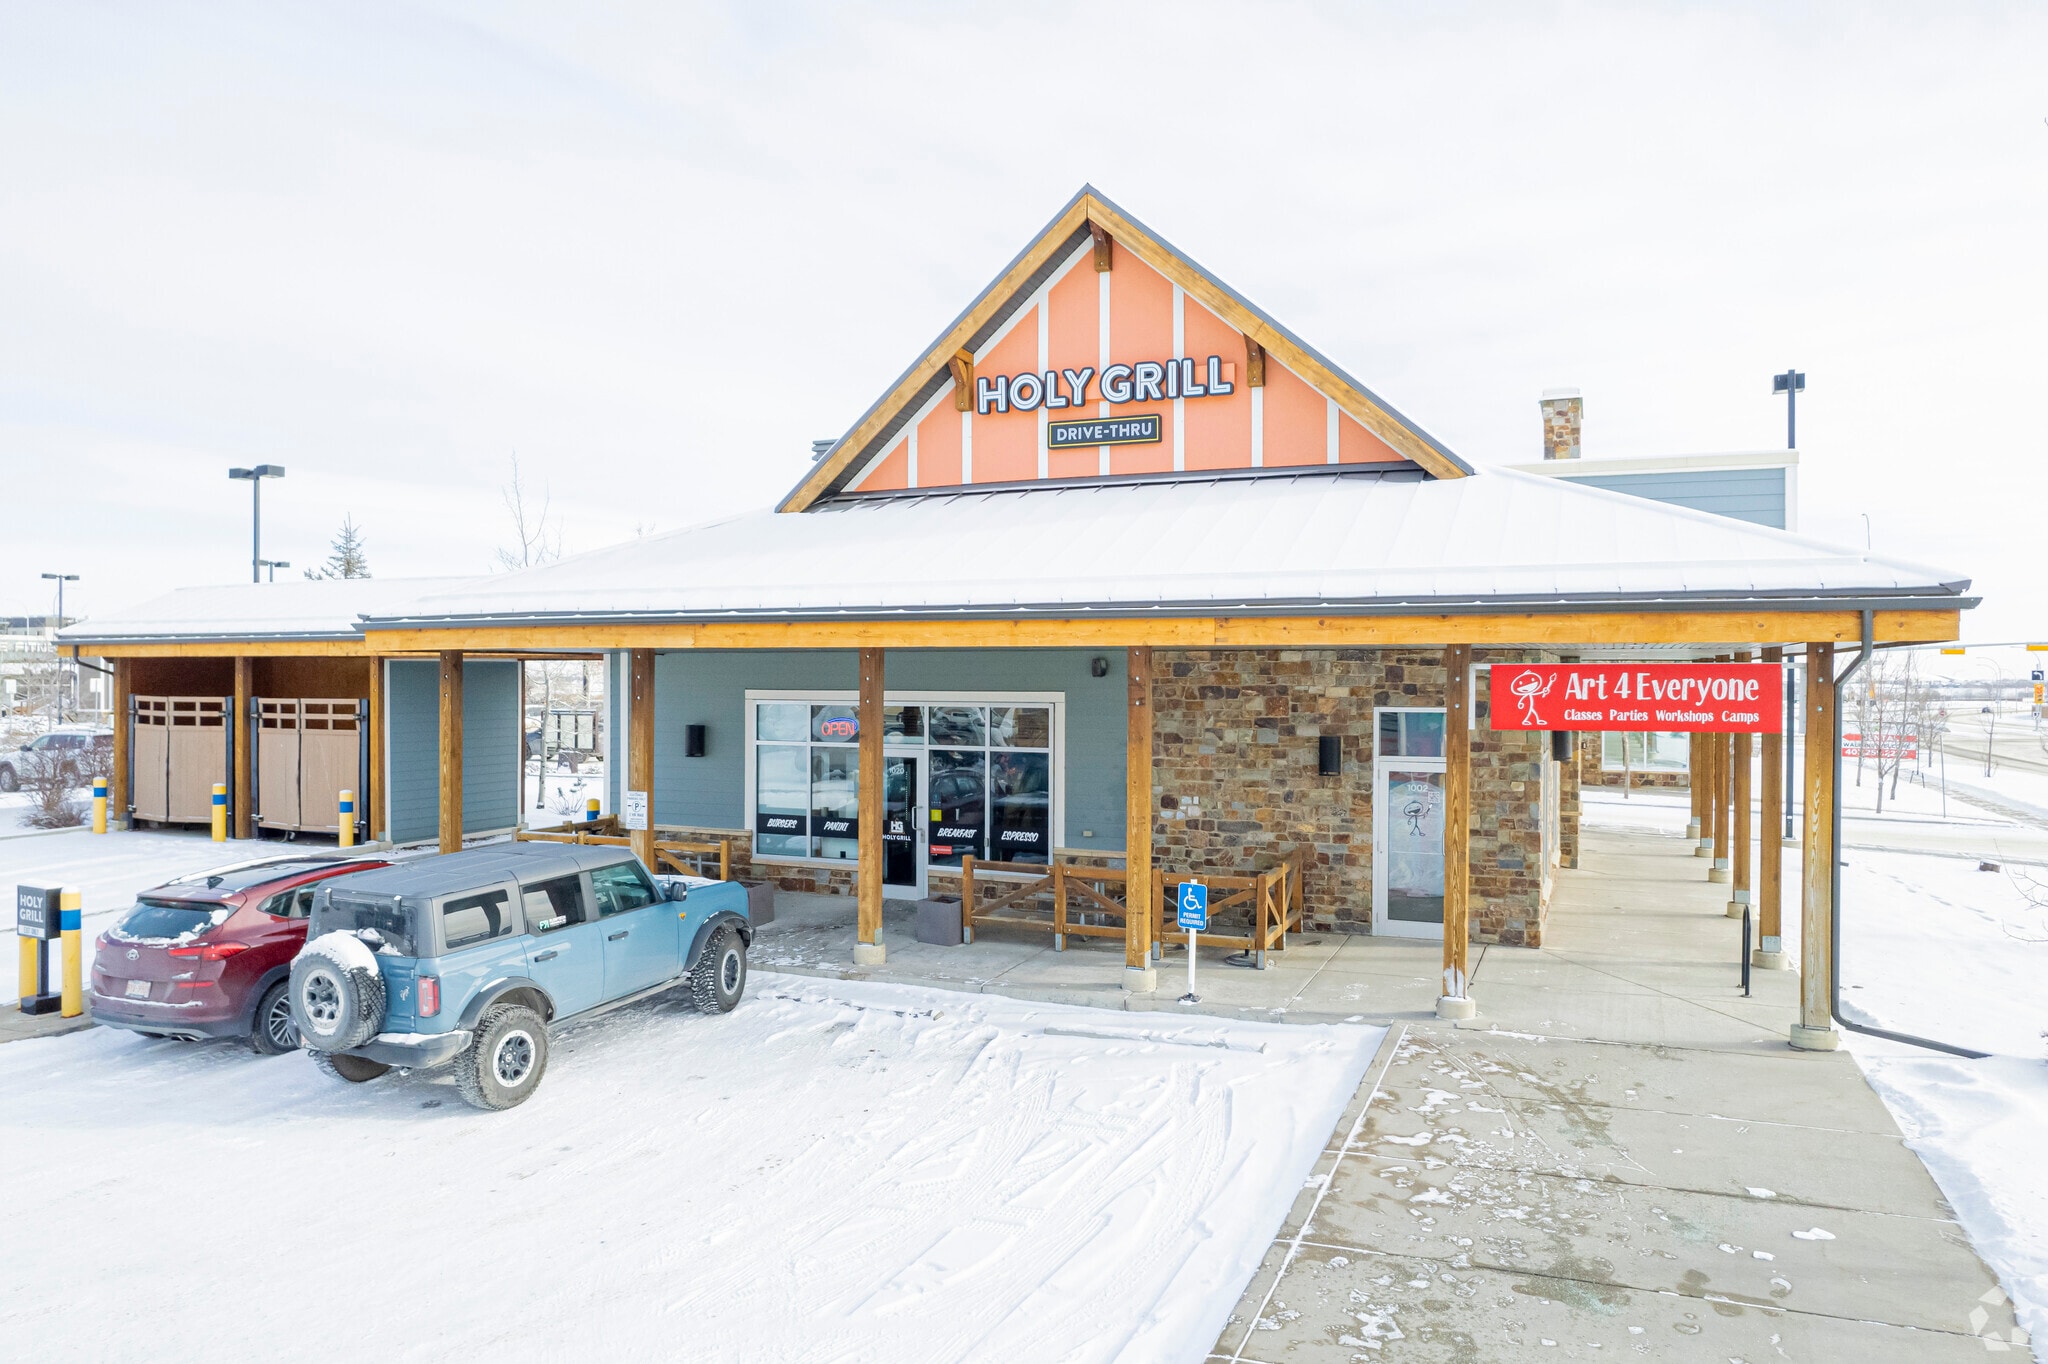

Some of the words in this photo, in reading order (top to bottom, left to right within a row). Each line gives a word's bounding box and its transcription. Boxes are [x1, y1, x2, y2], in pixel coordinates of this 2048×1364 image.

[977, 367, 1094, 414] HOLY
[1100, 355, 1234, 403] GRILL
[1056, 422, 1152, 441] DRIVE-THRU
[15, 642, 58, 652] FITNE
[1565, 672, 1608, 701] Art
[1614, 672, 1631, 700] 4
[1637, 672, 1759, 706] Everyone
[1564, 709, 1602, 721] Classes
[1609, 709, 1648, 721] Parties
[1656, 709, 1714, 724] Workshops
[1722, 710, 1759, 724] Camps
[821, 721, 856, 736] OPEN
[889, 767, 905, 775] 1020
[1407, 784, 1429, 792] 1002
[634, 802, 640, 811] P
[767, 818, 797, 829] BURGERS
[823, 821, 850, 832] PANINI
[937, 827, 977, 839] BREAKFAST
[1001, 831, 1039, 842] ESPRESSO
[20, 894, 43, 908] HOLY
[20, 908, 43, 923] GRILL
[1180, 918, 1204, 926] REQUIRED
